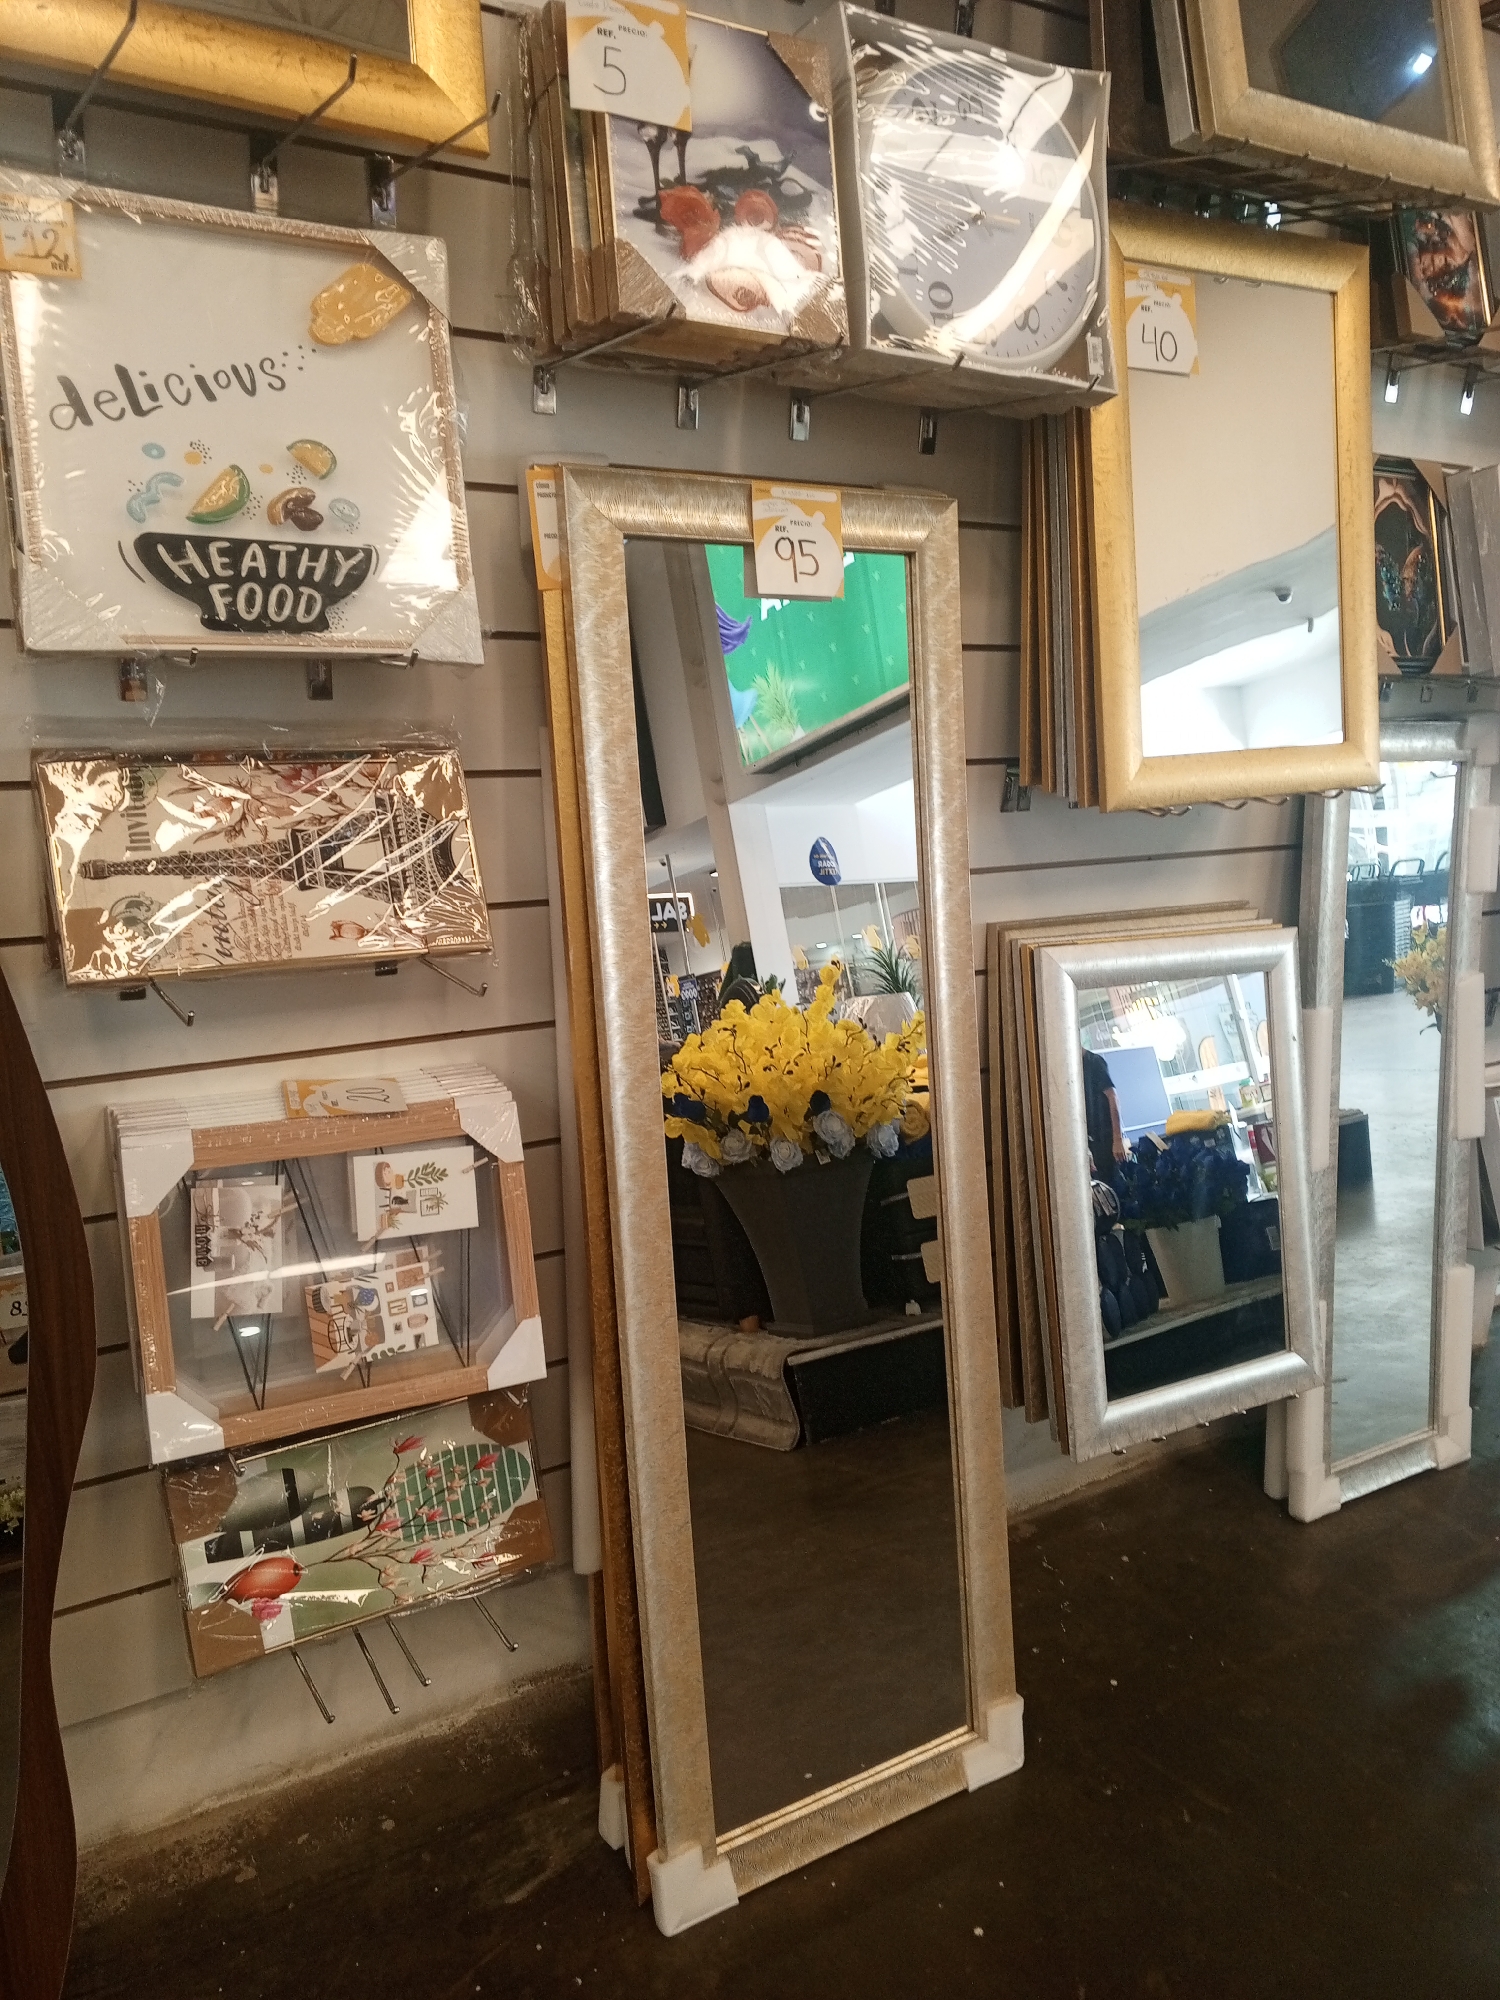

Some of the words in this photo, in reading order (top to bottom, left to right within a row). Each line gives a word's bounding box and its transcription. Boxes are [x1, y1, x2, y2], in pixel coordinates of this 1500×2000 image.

[593, 45, 627, 95] 5
[928, 281, 954, 324] 10
[1014, 304, 1041, 335] 8
[1142, 323, 1177, 362] 40
[157, 540, 365, 587] HEATHY
[774, 536, 820, 583] 95
[208, 582, 323, 623] FOOD
[345, 1087, 390, 1104] 20
